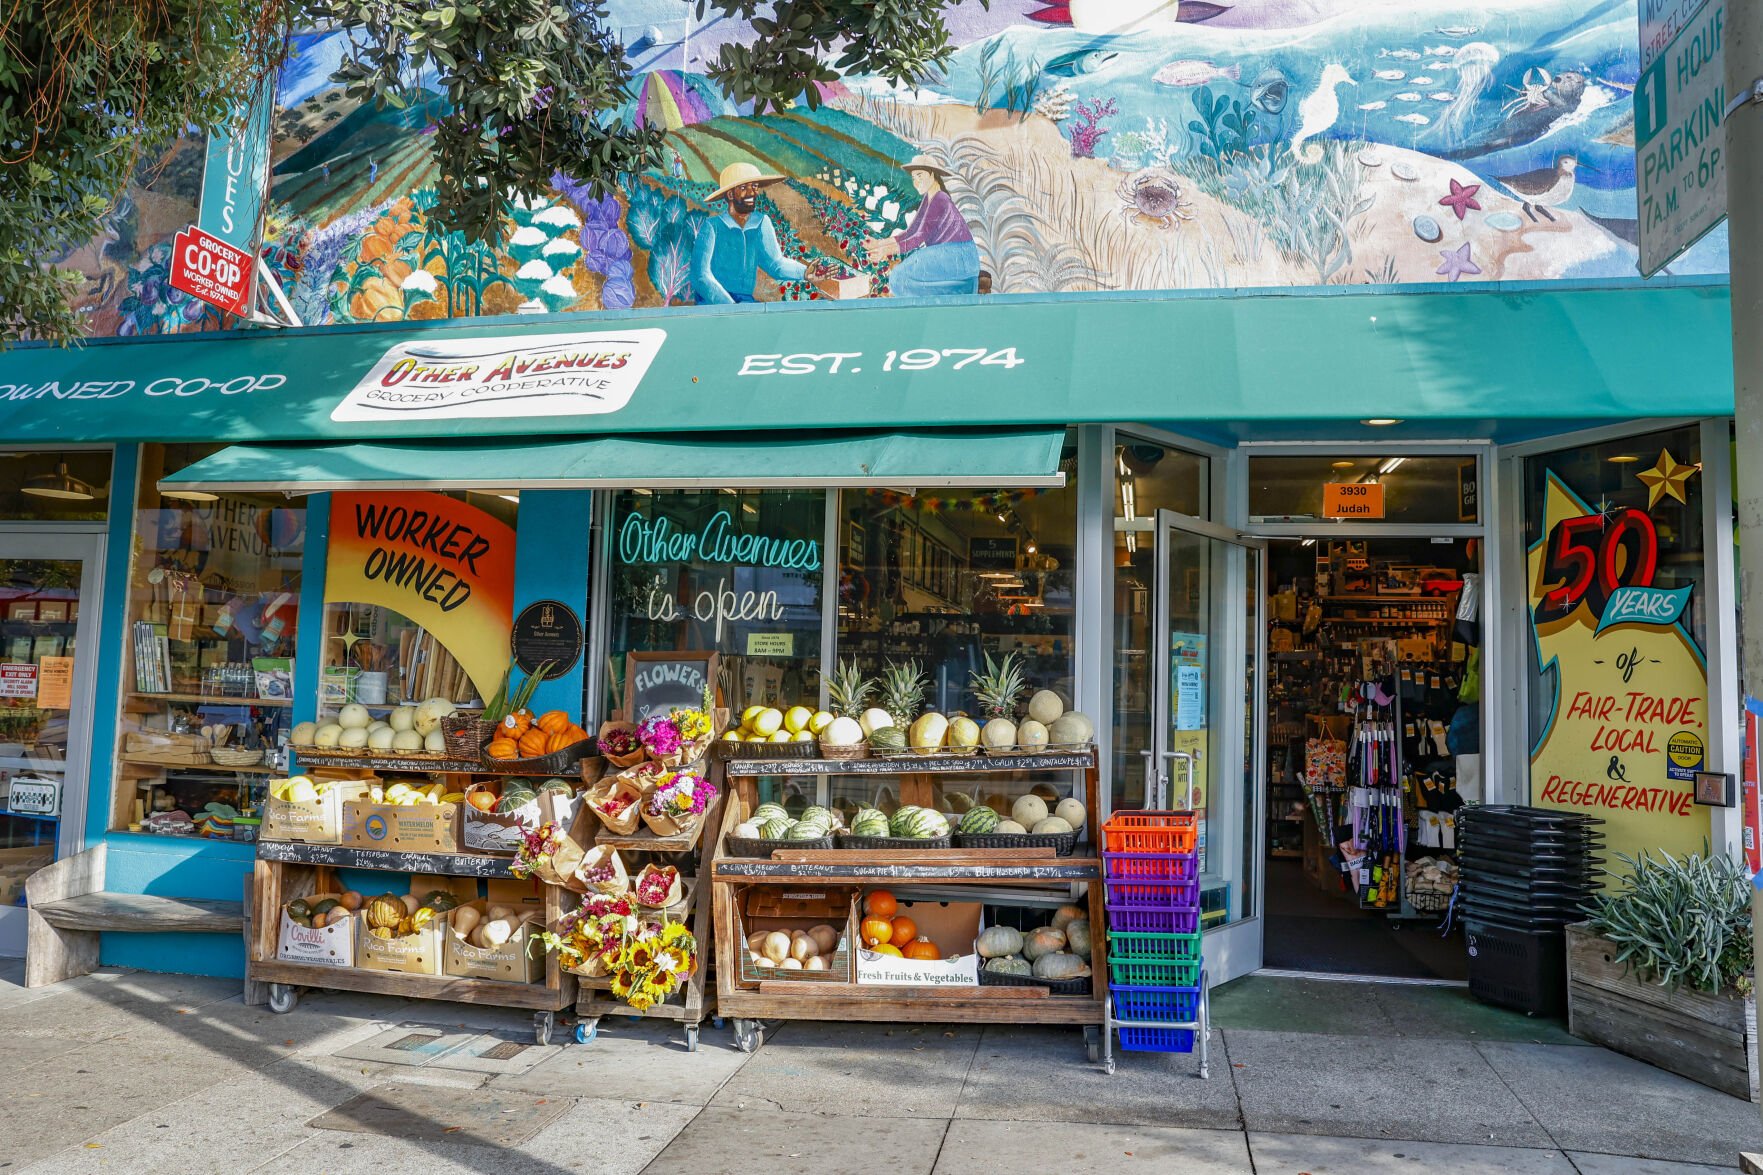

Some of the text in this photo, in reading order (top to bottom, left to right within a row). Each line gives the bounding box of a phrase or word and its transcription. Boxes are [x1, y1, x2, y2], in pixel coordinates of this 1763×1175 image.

[1646, 9, 1677, 65] STREET
[1645, 72, 1657, 135] 1
[1644, 83, 1725, 193] PARKIN
[1683, 170, 1694, 192] TO
[199, 236, 241, 264] GROCERY
[185, 244, 241, 287] CO-OP
[183, 268, 239, 300] WORKER OWNED
[381, 352, 632, 387] OTHER AVENUES
[737, 348, 1025, 375] EST. 1974
[144, 374, 287, 396] CO-OP
[366, 377, 612, 402] GROCERY COOPERATIVE
[1340, 487, 1367, 496] 3930
[1336, 504, 1370, 514] Judah
[356, 503, 490, 577] WORKER
[620, 511, 820, 571] Other Avenues
[1547, 508, 1658, 601] 50
[364, 547, 471, 612] OWNED
[648, 574, 784, 643] is open
[1610, 588, 1678, 618] YEARS
[635, 663, 707, 694] FLOWERS
[1590, 727, 1661, 754] LOCAL
[1670, 745, 1701, 754] CAUTION
[1606, 755, 1631, 783] &
[1541, 775, 1695, 817] REGENERATIVE
[455, 856, 496, 866] BUTTERNUT
[791, 864, 835, 872] BUTTERNUT
[853, 867, 875, 876] SUGAR
[877, 867, 888, 875] PIE
[291, 925, 325, 944] Covilli
[363, 936, 426, 954] Rico Farms
[453, 942, 516, 961] Rico Farms
[858, 970, 974, 984] Fresh Fruits & Vegetables
